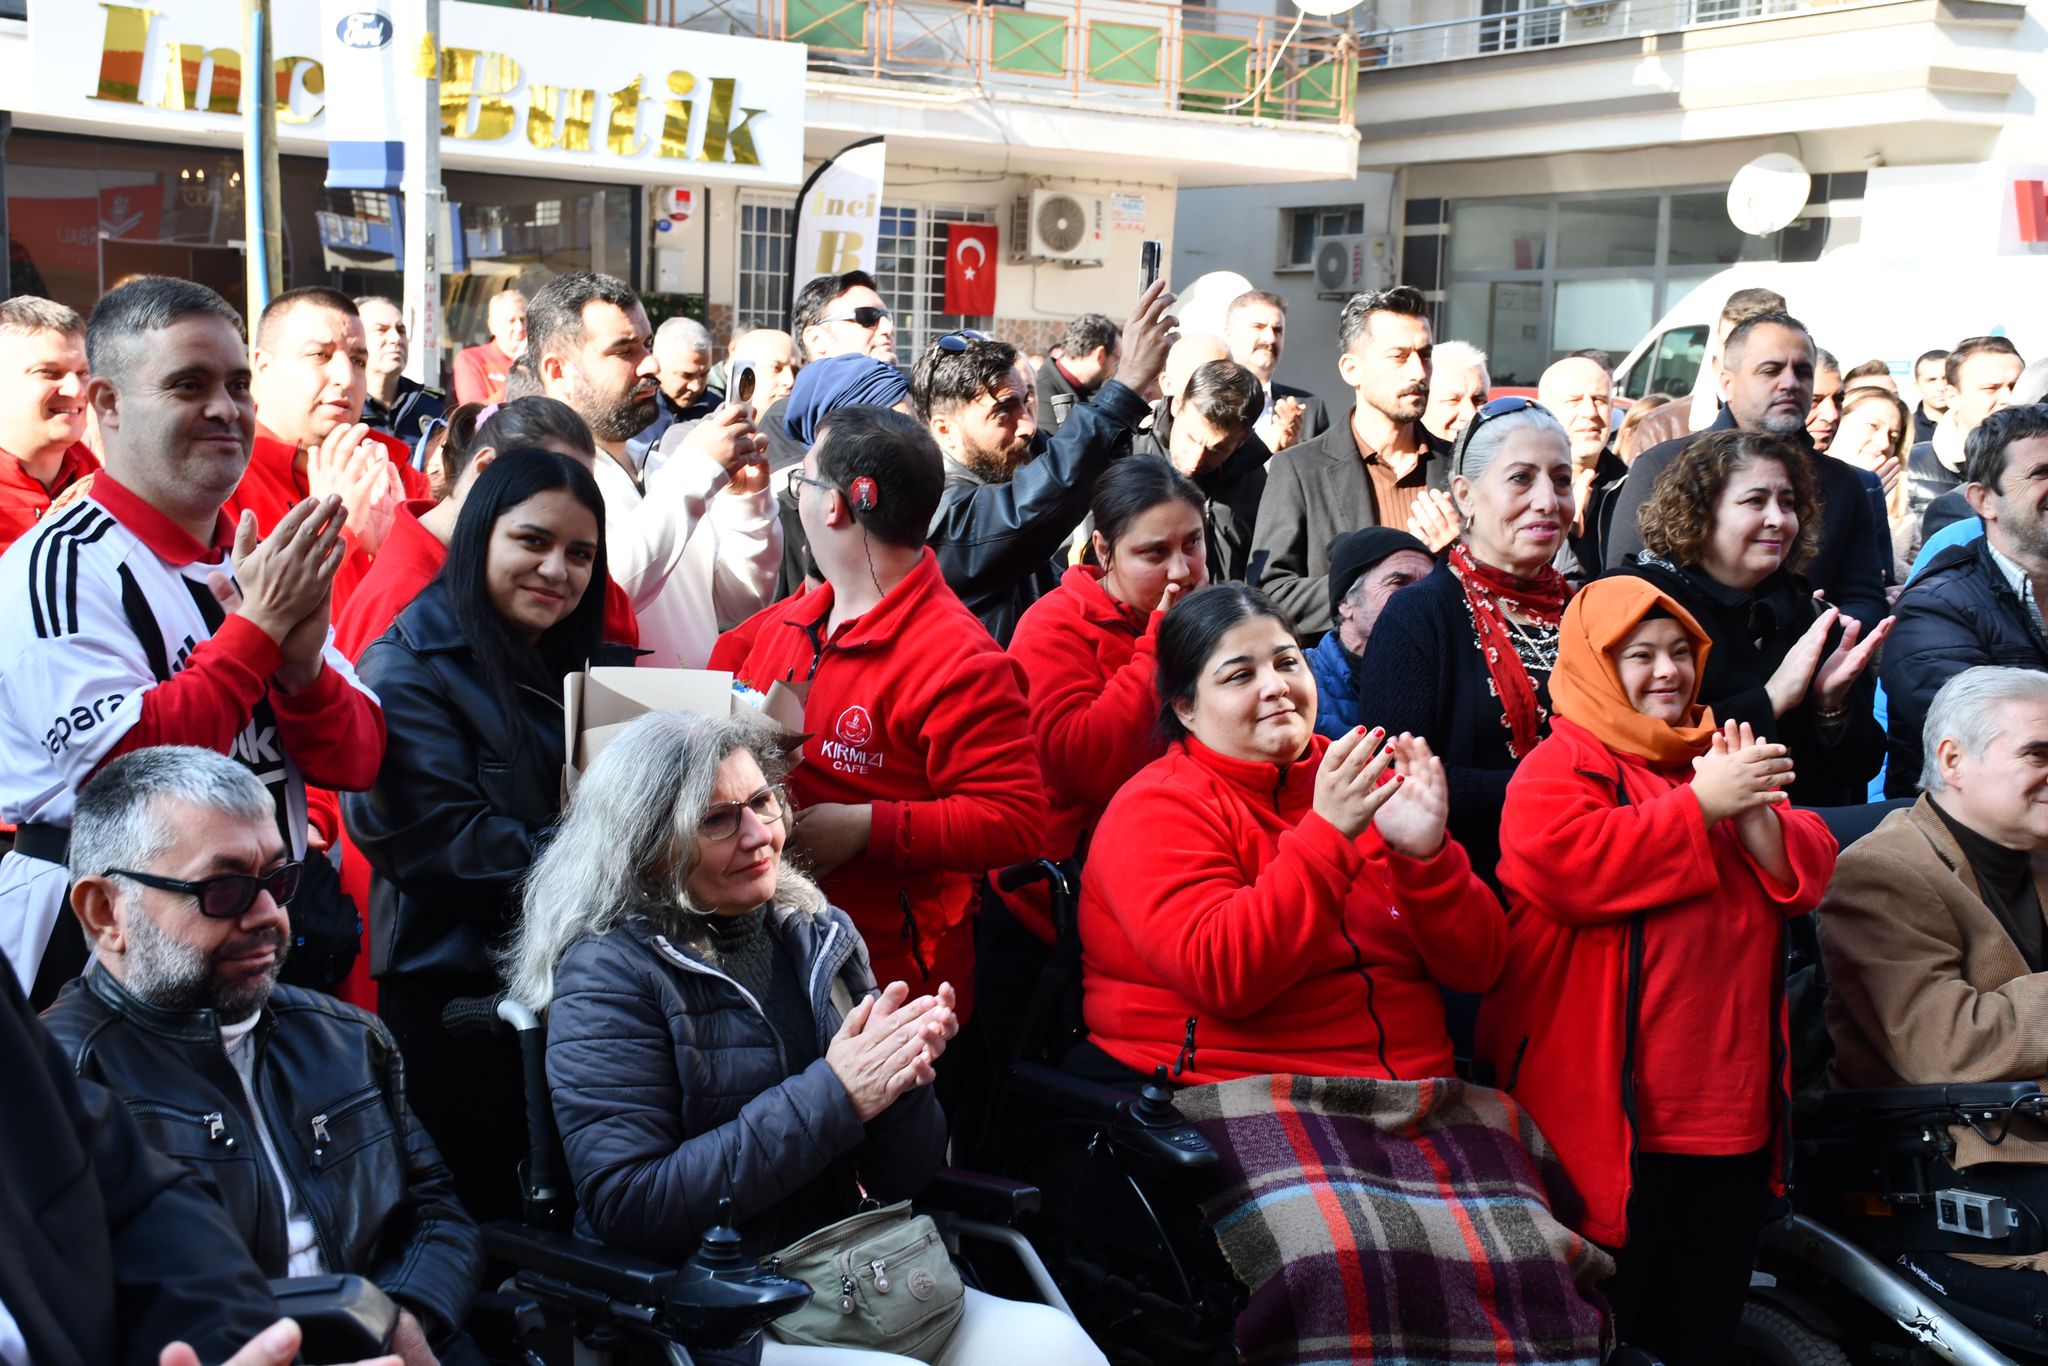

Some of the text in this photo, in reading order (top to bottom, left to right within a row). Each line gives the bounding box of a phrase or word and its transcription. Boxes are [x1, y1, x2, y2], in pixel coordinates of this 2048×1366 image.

[86, 3, 767, 166] Inc Butik
[41, 694, 125, 760] apara
[821, 739, 883, 768] KIRMIZI
[832, 760, 868, 774] CAFE
